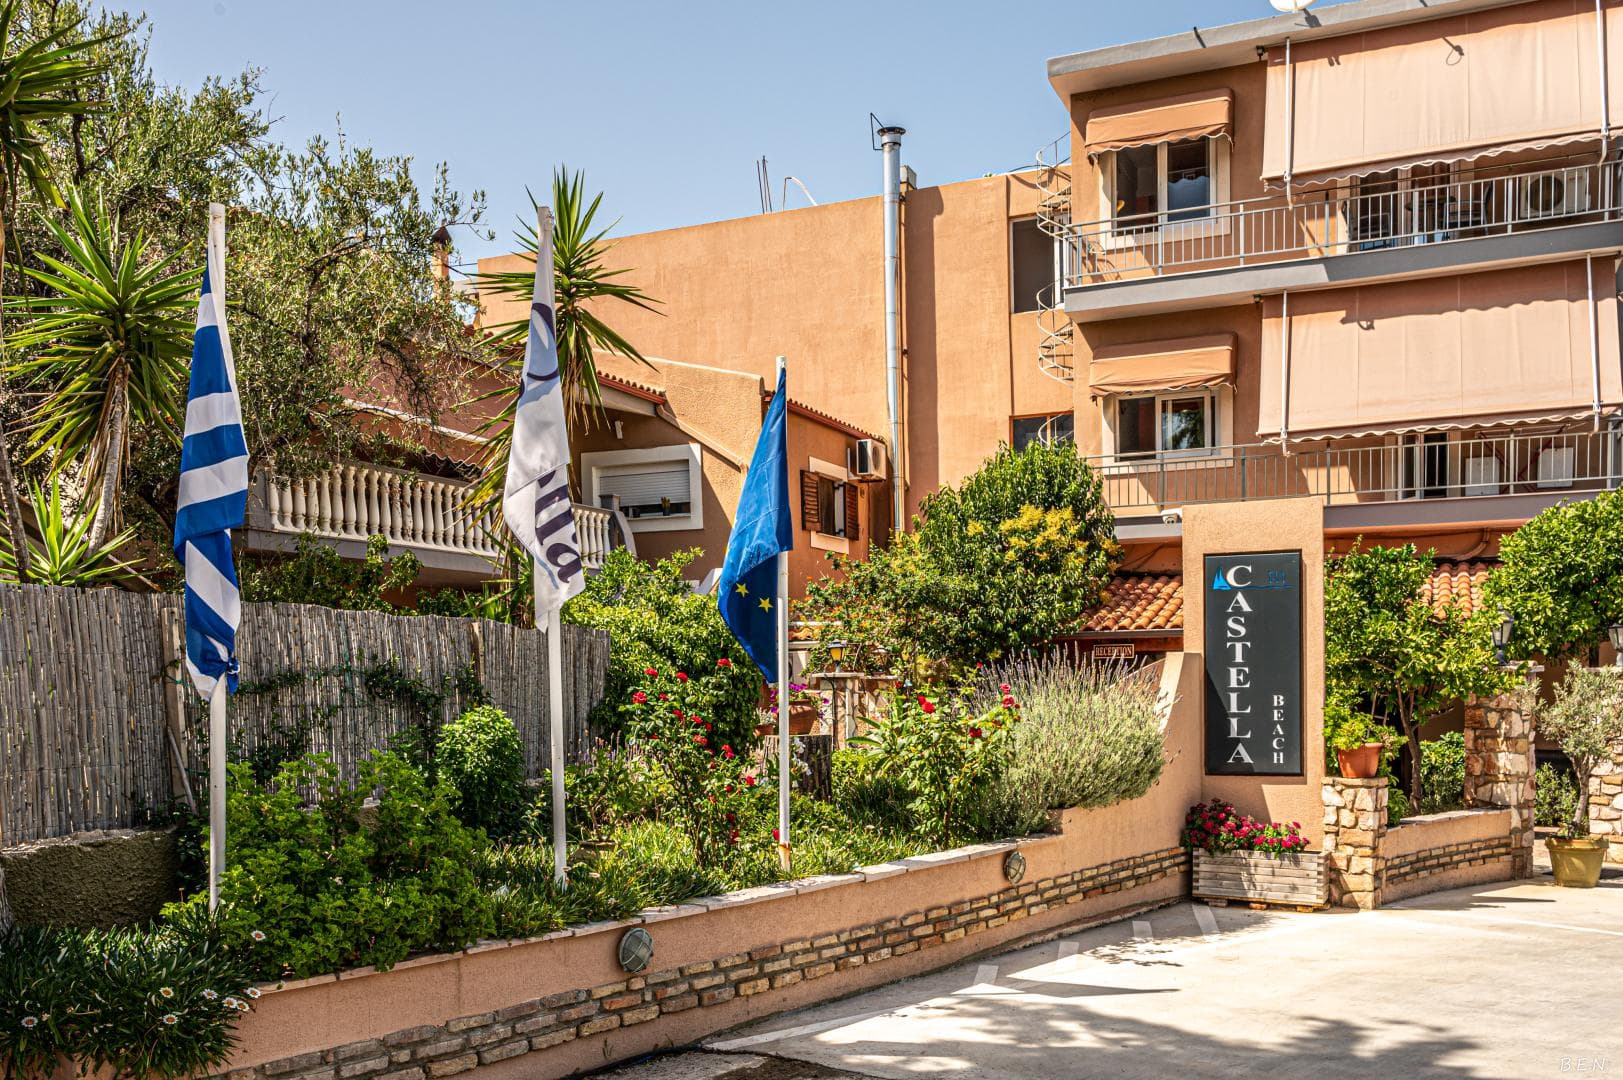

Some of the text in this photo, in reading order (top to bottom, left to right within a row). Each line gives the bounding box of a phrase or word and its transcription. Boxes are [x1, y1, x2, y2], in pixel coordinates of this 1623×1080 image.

[1095, 646, 1132, 657] RECEPTION
[1226, 565, 1253, 764] CASTELLA
[1272, 695, 1285, 764] BEACH
